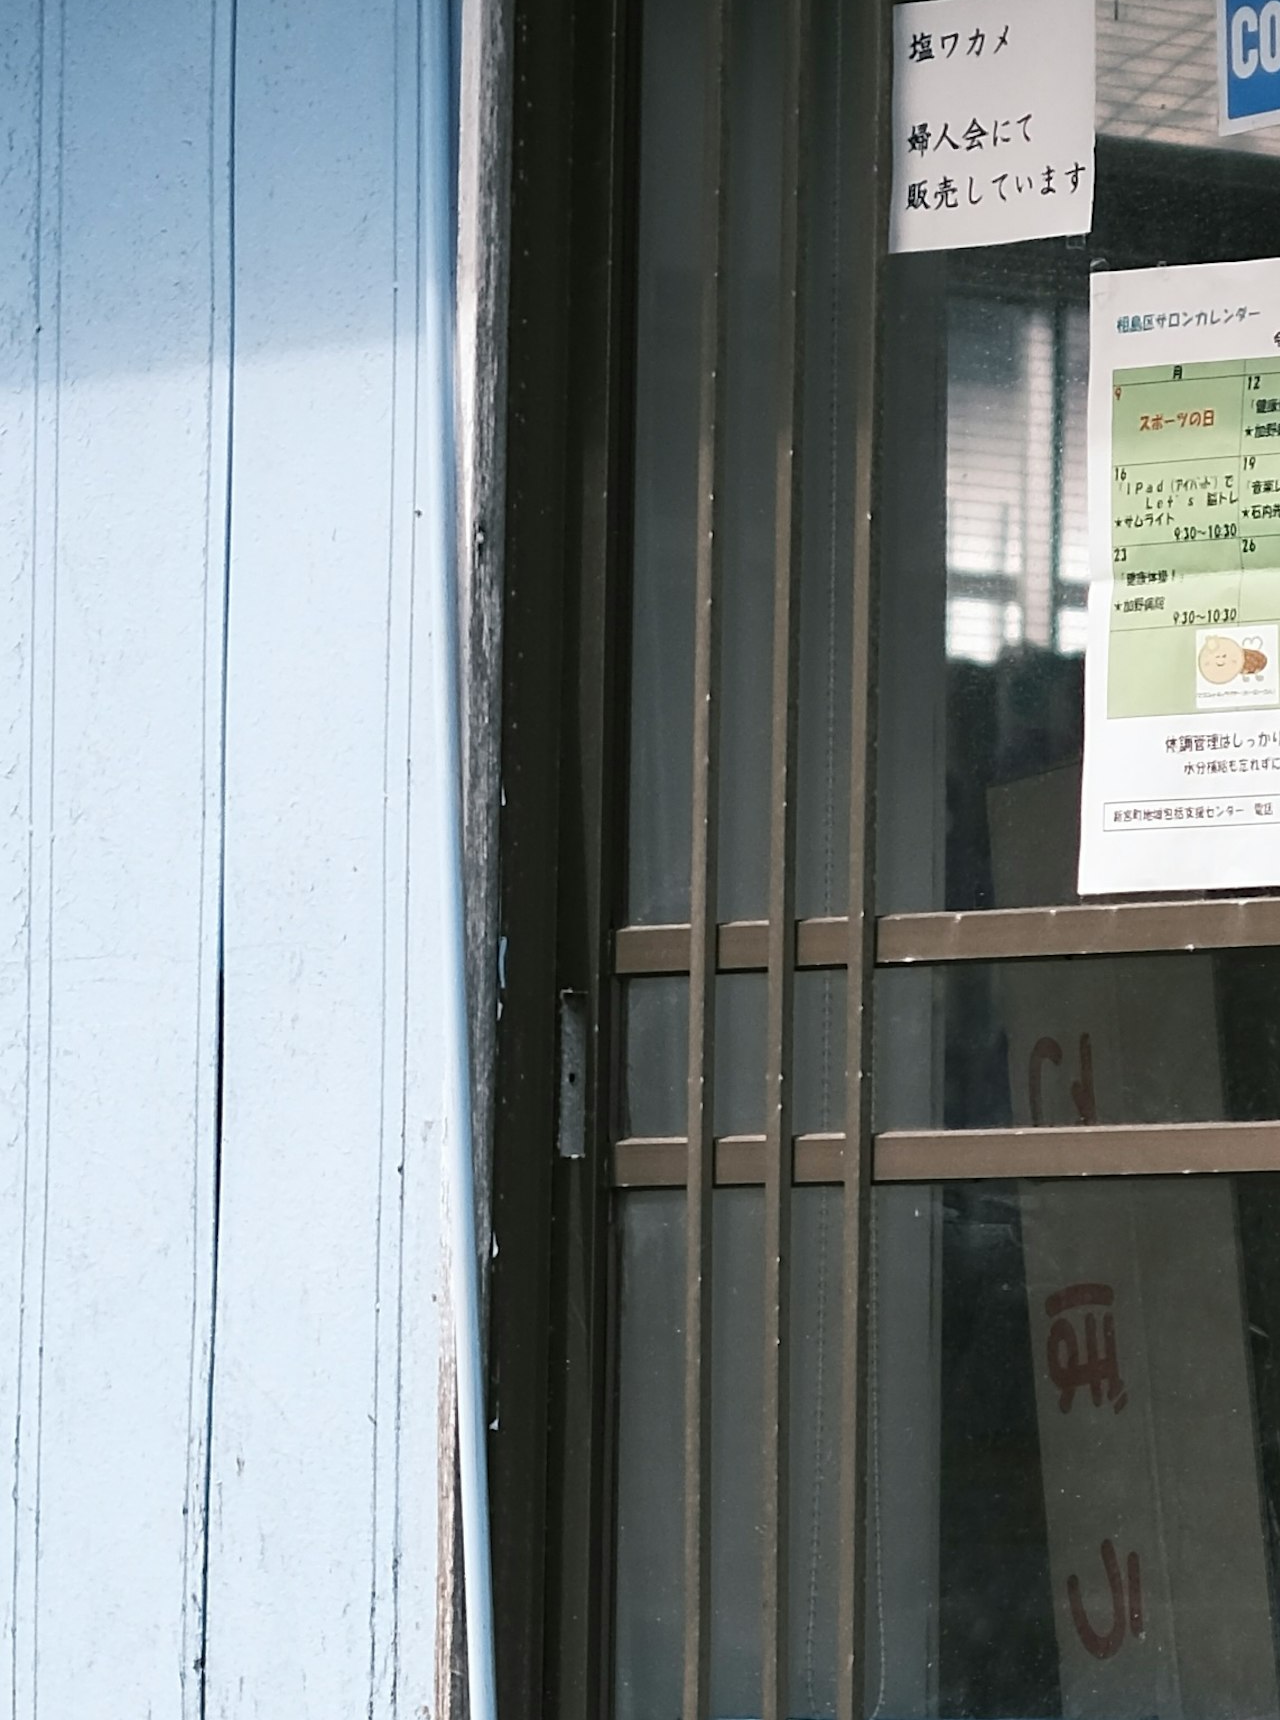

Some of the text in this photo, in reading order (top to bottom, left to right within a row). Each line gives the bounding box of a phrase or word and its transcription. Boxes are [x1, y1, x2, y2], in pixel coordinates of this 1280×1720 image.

[908, 24, 1012, 63] 塩ワカメ
[907, 113, 1034, 156] 婦人会にて
[905, 162, 1087, 211] 販売しています
[1117, 306, 1261, 334] 相島区サロンカレンダー
[1172, 365, 1183, 379] 月
[1247, 376, 1260, 390] 12
[1114, 386, 1121, 400] 9
[1139, 410, 1214, 431] スポーツの日
[1243, 457, 1256, 471] 19
[1115, 468, 1126, 481] 16
[1242, 539, 1256, 553] 26
[1113, 548, 1127, 563] 23
